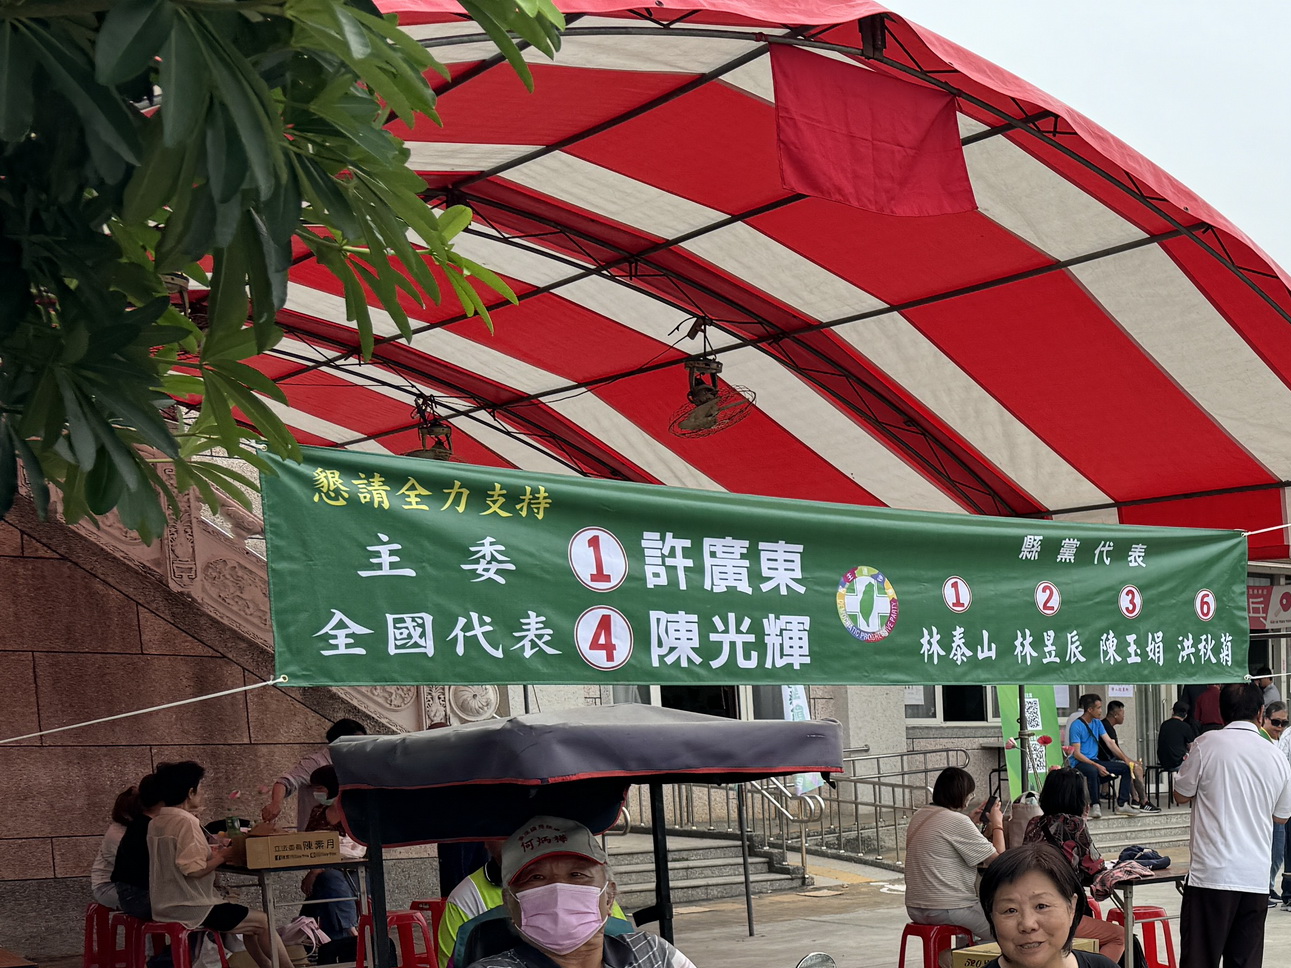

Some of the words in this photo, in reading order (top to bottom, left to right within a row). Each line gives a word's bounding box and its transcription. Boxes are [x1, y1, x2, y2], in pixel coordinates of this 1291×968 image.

[313, 466, 552, 520] 懇請全力支持
[641, 531, 807, 596] 許廣東
[1019, 534, 1147, 568] 縣黨代表
[312, 608, 562, 659] 全國代表
[649, 610, 811, 670] 陳光輝
[920, 625, 997, 666] 林泰山
[1014, 628, 1087, 666] 林昱辰
[1100, 629, 1164, 666] 陳玉娟
